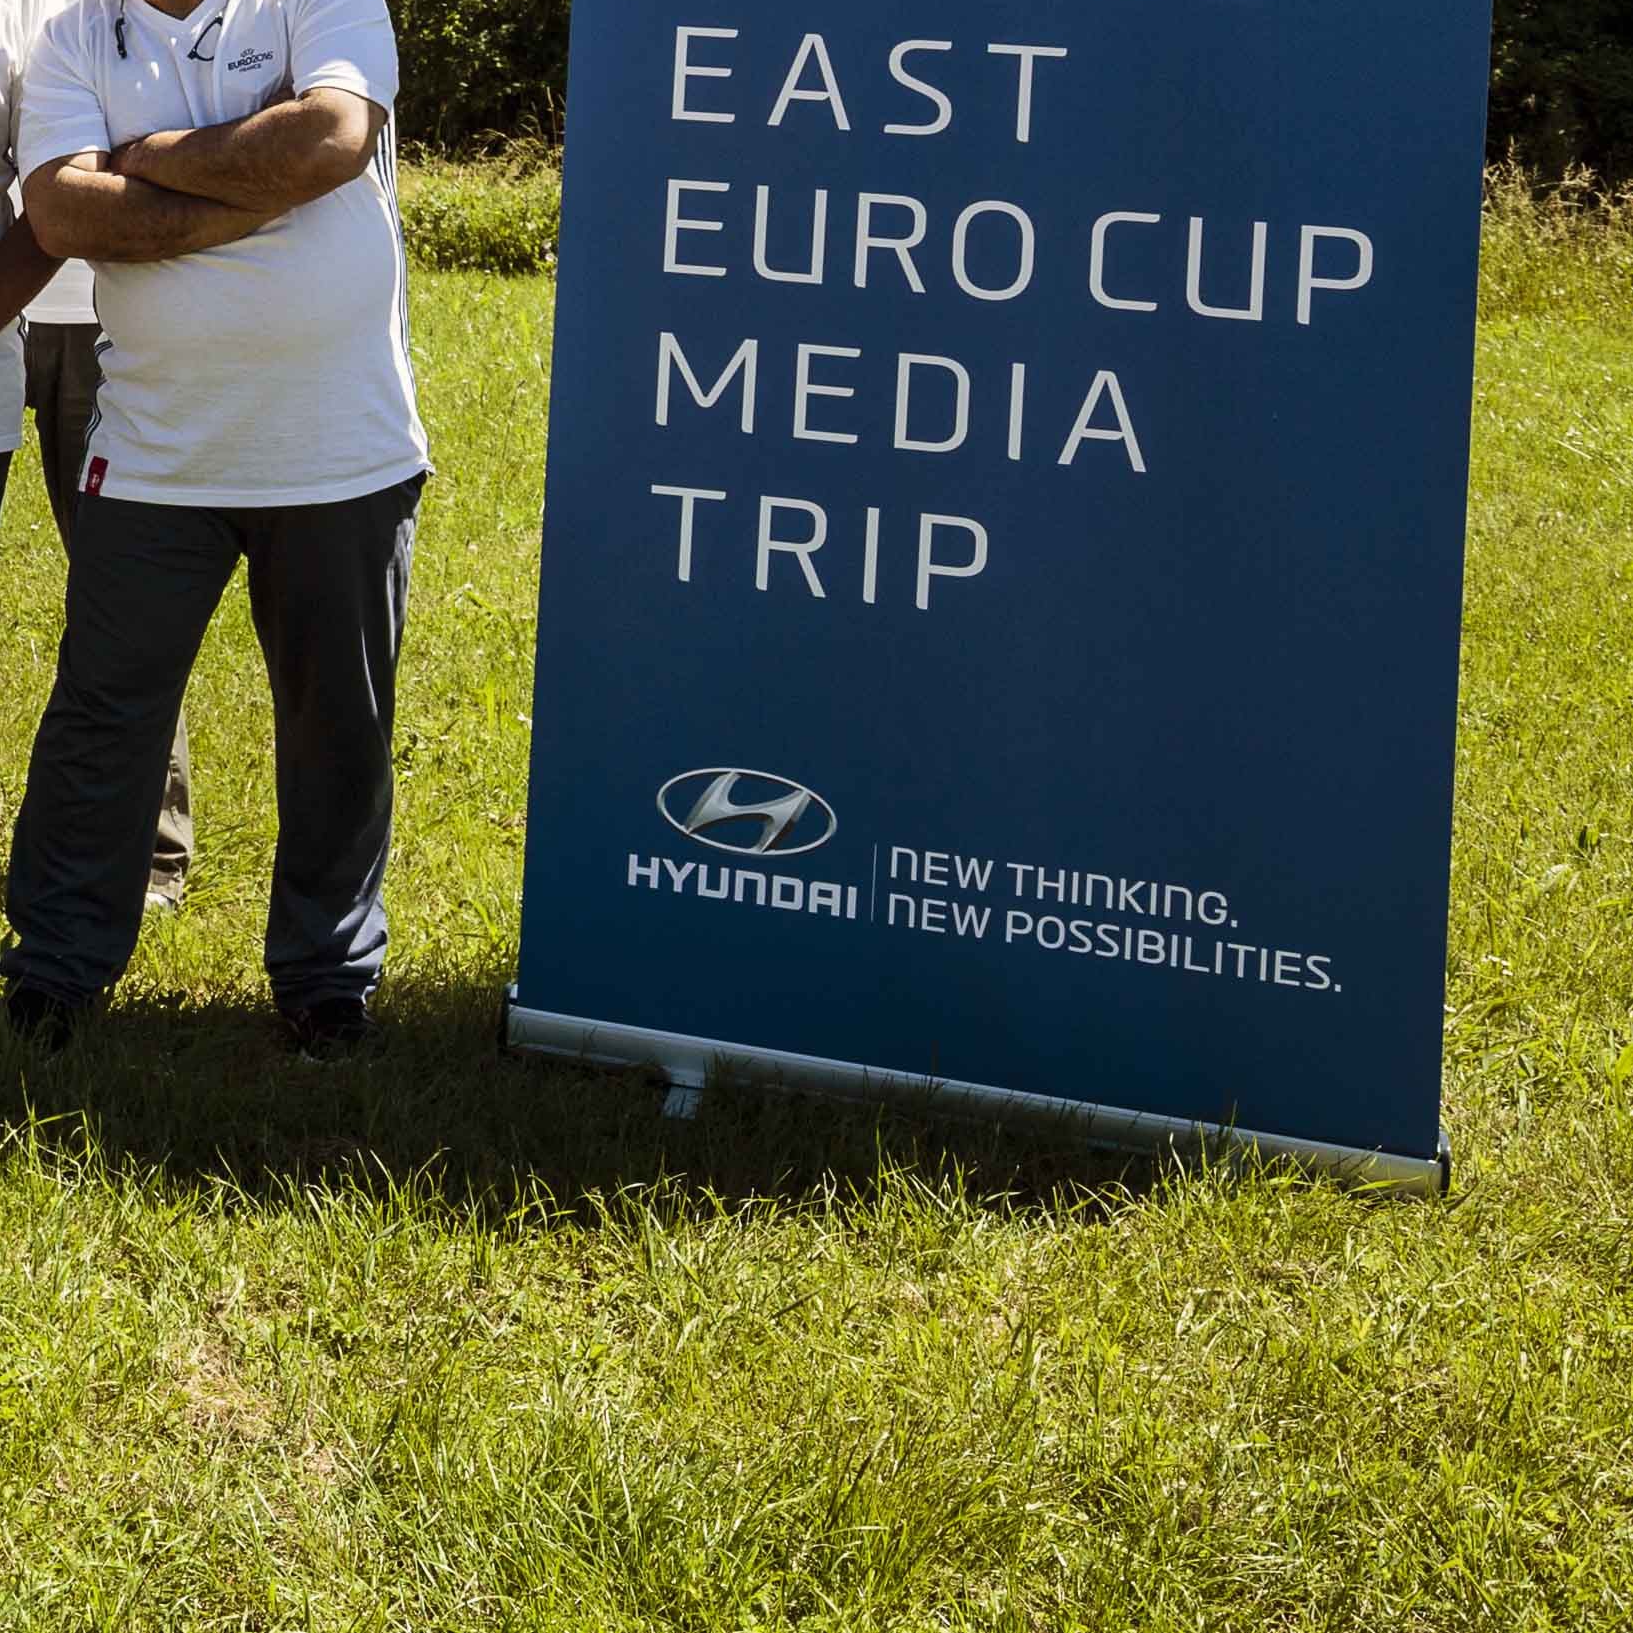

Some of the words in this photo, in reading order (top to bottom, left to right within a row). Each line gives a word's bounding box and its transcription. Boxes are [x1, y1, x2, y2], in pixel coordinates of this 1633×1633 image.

[671, 25, 1068, 143] EAST
[662, 178, 1035, 301] EURO
[1089, 211, 1374, 325] CUP
[655, 331, 1147, 473] MEDIA
[650, 484, 988, 610] TRIP
[627, 853, 857, 919] HYUNDAI
[888, 893, 992, 939] NEW
[1005, 910, 1342, 993] POSSIBILITIES.
[890, 846, 994, 891] NEW
[1006, 862, 1238, 928] THINKING.
